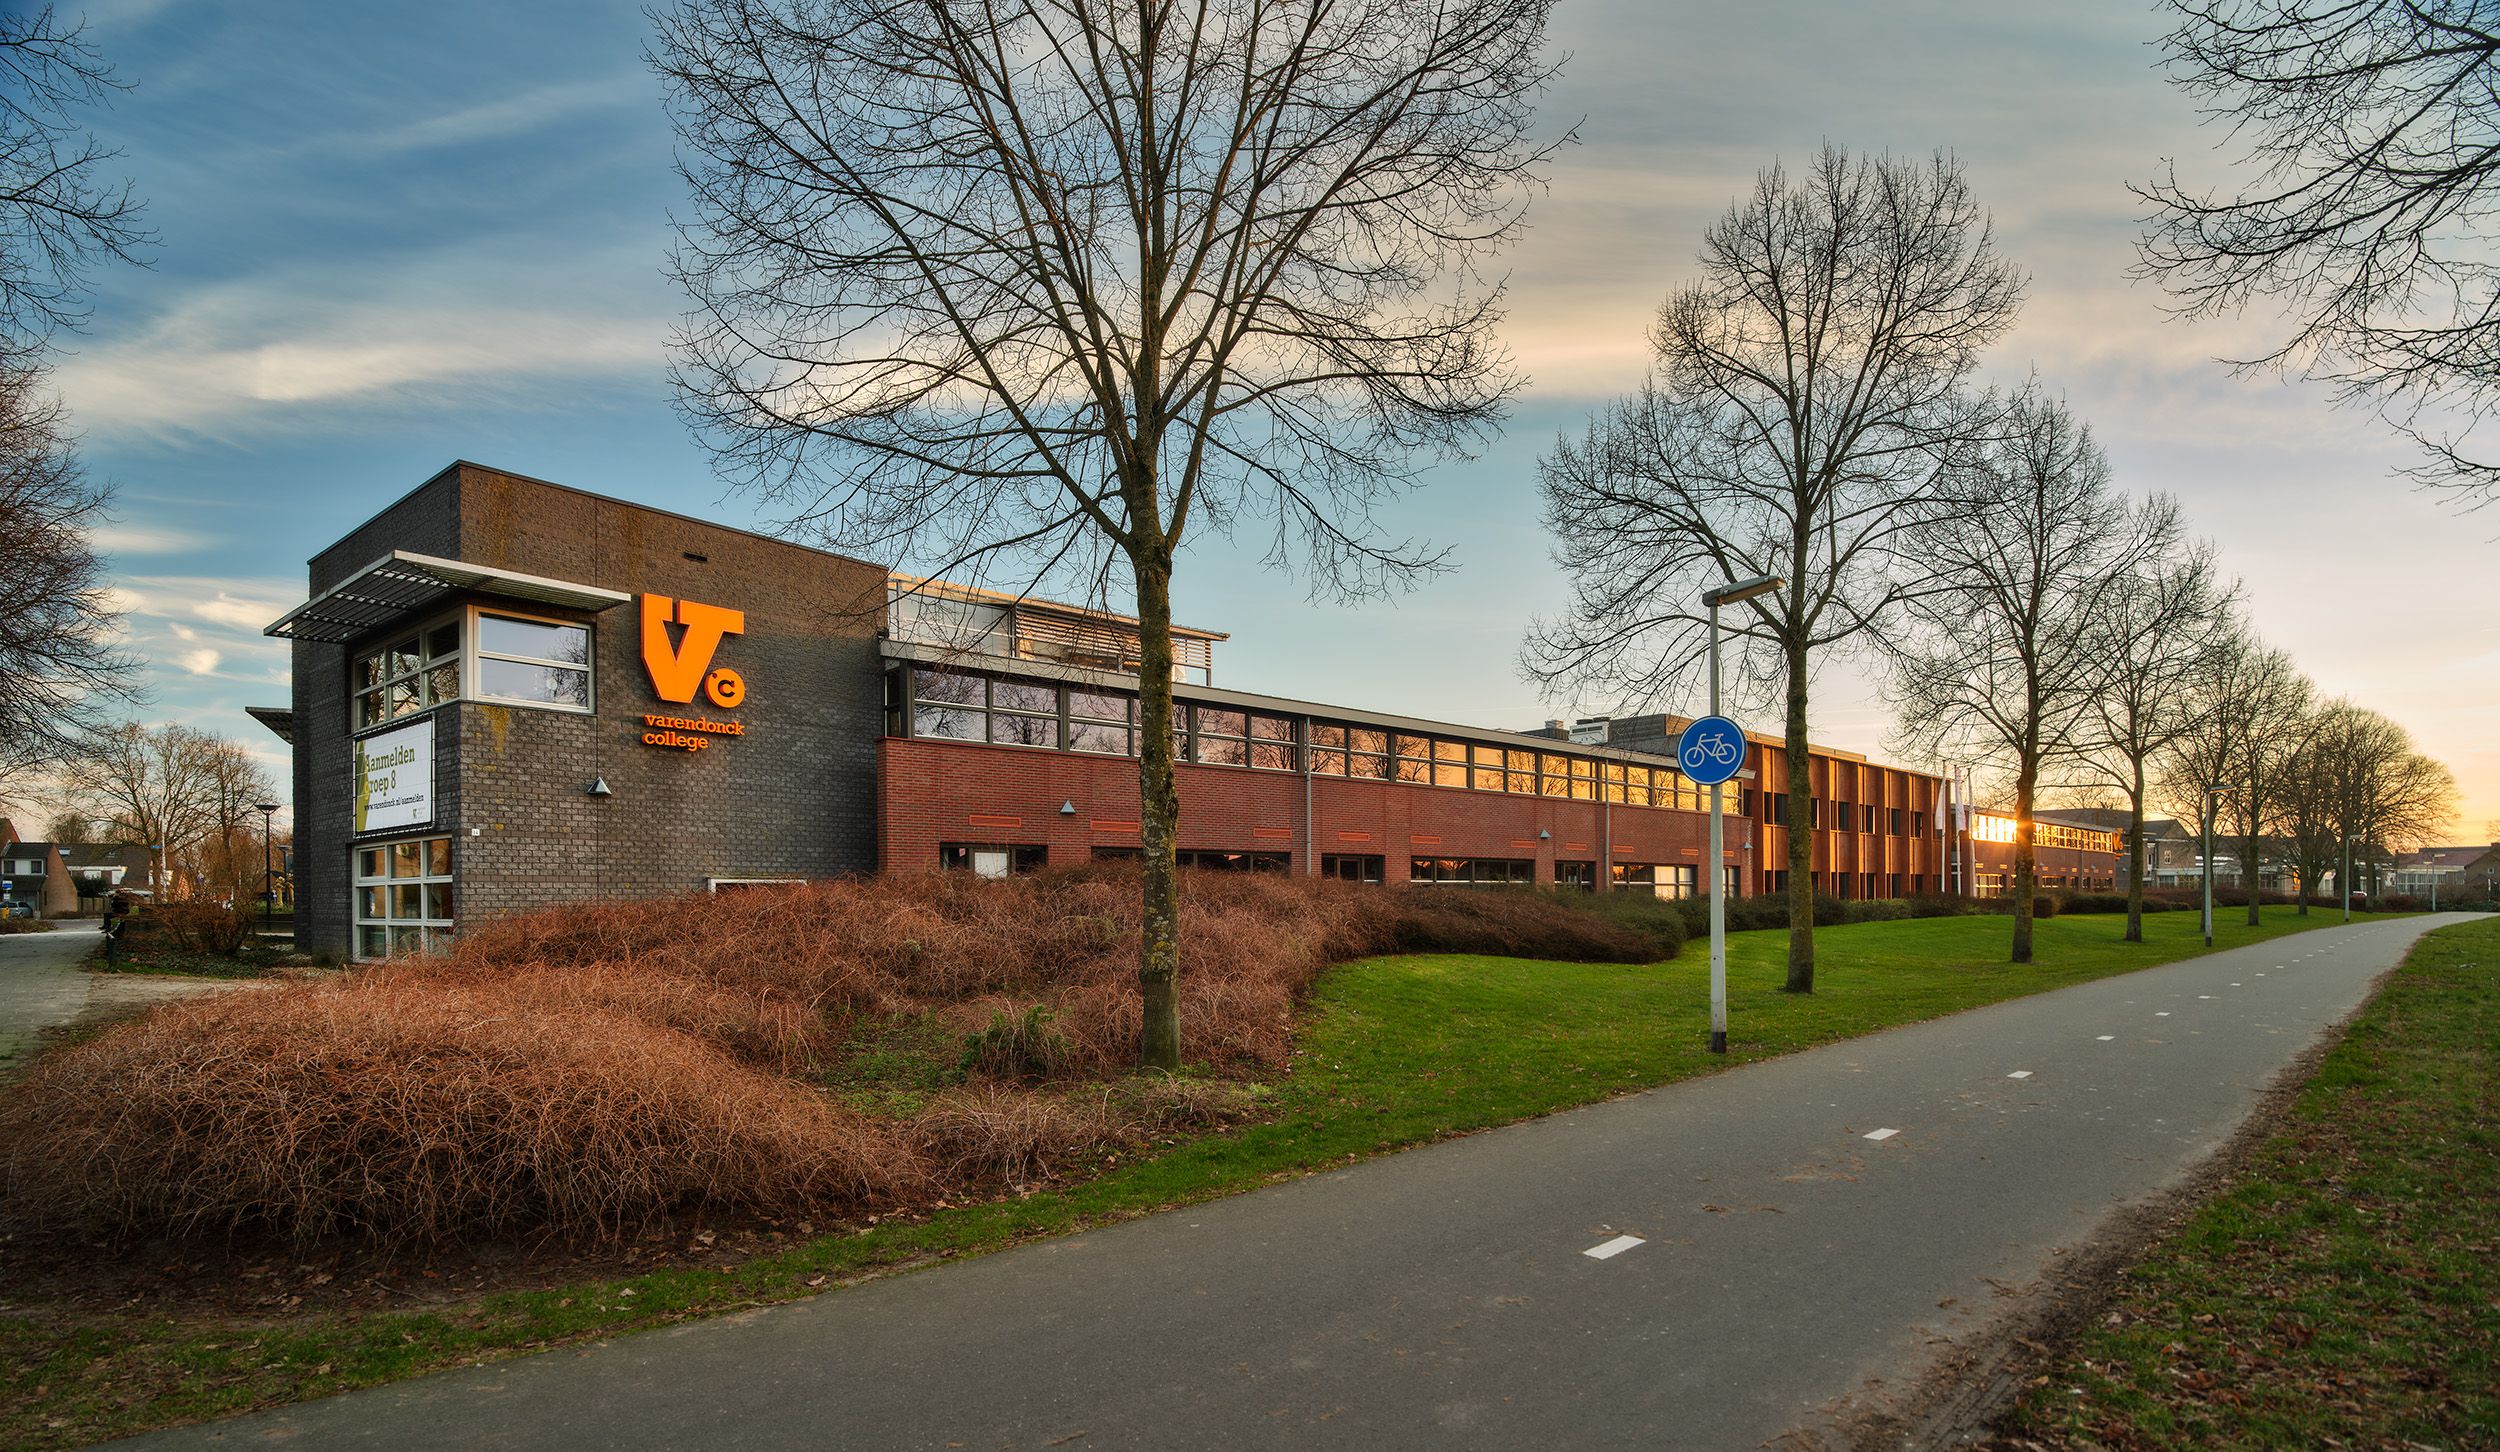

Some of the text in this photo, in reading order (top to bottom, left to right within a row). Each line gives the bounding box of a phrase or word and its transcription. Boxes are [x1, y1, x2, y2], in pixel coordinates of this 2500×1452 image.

[643, 713, 745, 736] varendonck
[642, 731, 709, 752] college
[365, 745, 415, 772] Aanmelden
[391, 769, 396, 789] 8
